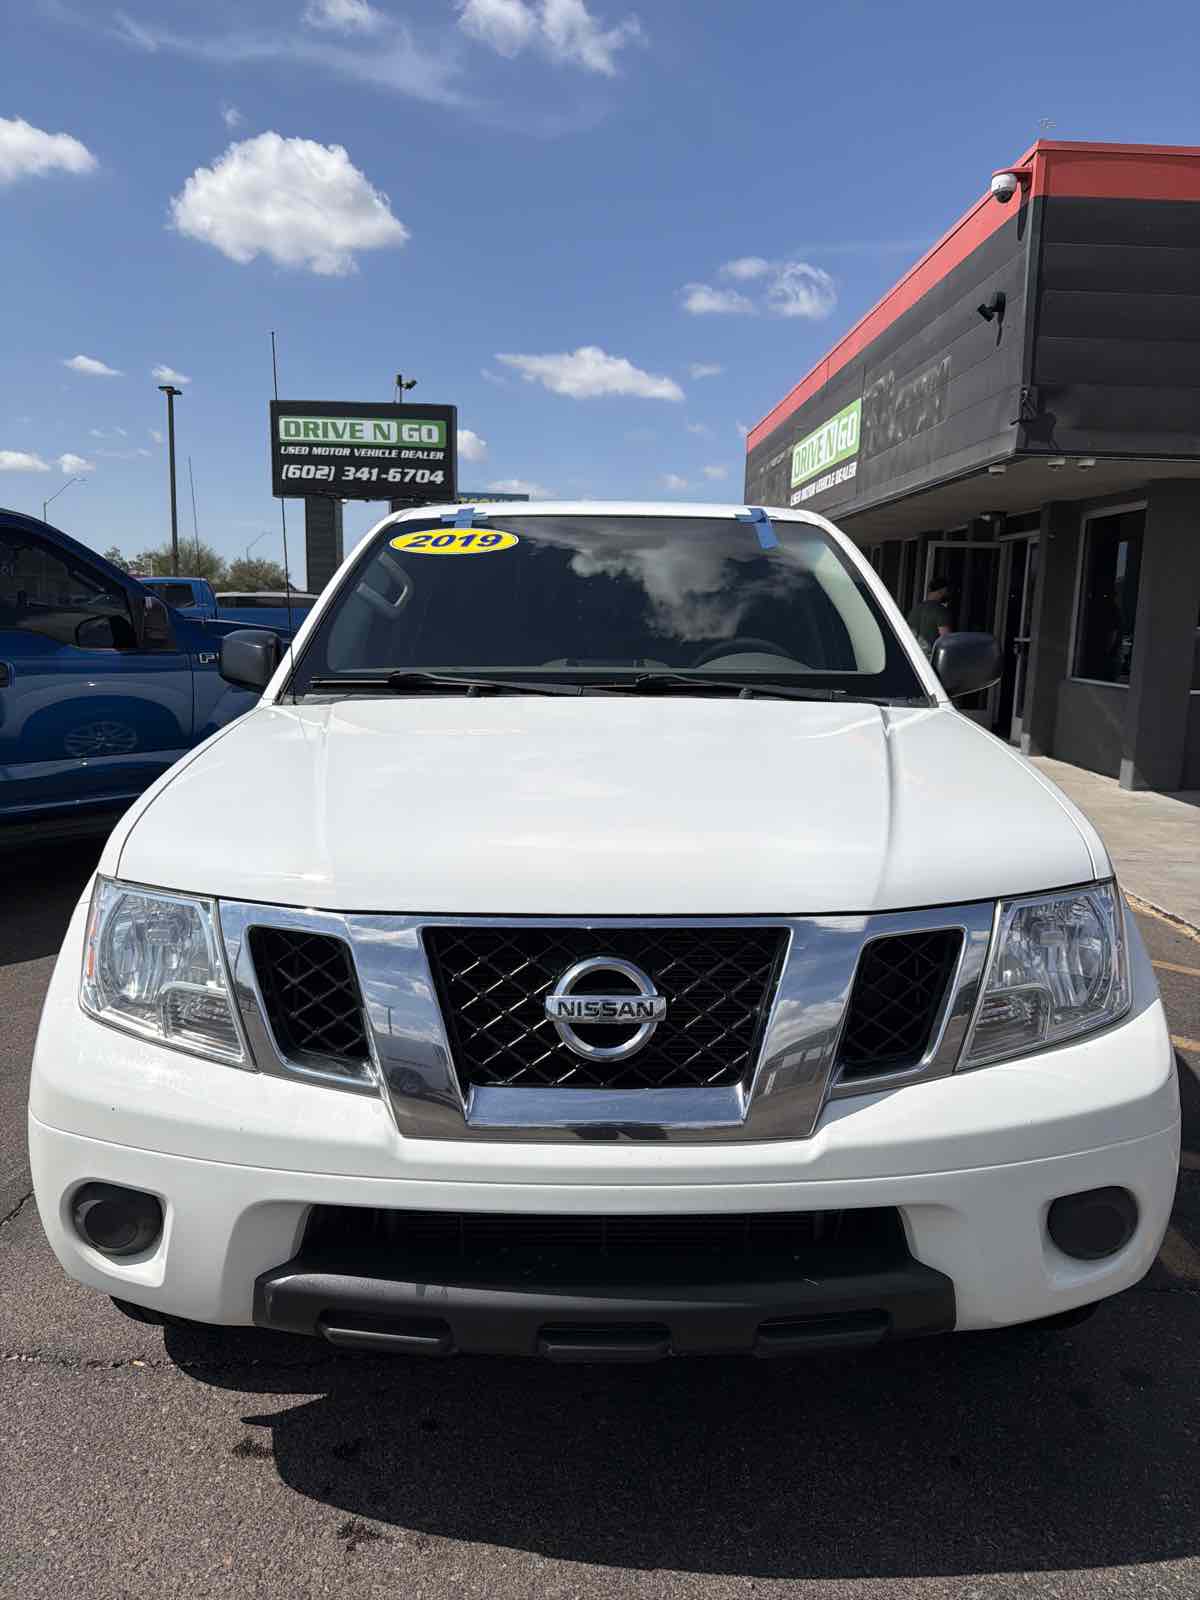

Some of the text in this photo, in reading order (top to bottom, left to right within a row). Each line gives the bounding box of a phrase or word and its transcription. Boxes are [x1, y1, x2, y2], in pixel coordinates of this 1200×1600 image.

[283, 420, 439, 443] DRIVE N GO
[280, 446, 444, 460] USED MOTOR VEHICLE DEALER
[794, 432, 824, 479] DRIVE
[838, 410, 858, 452] GO
[282, 464, 444, 484] (602) 341-6704
[403, 533, 503, 548] 2019
[557, 1001, 654, 1017] NISSAN
